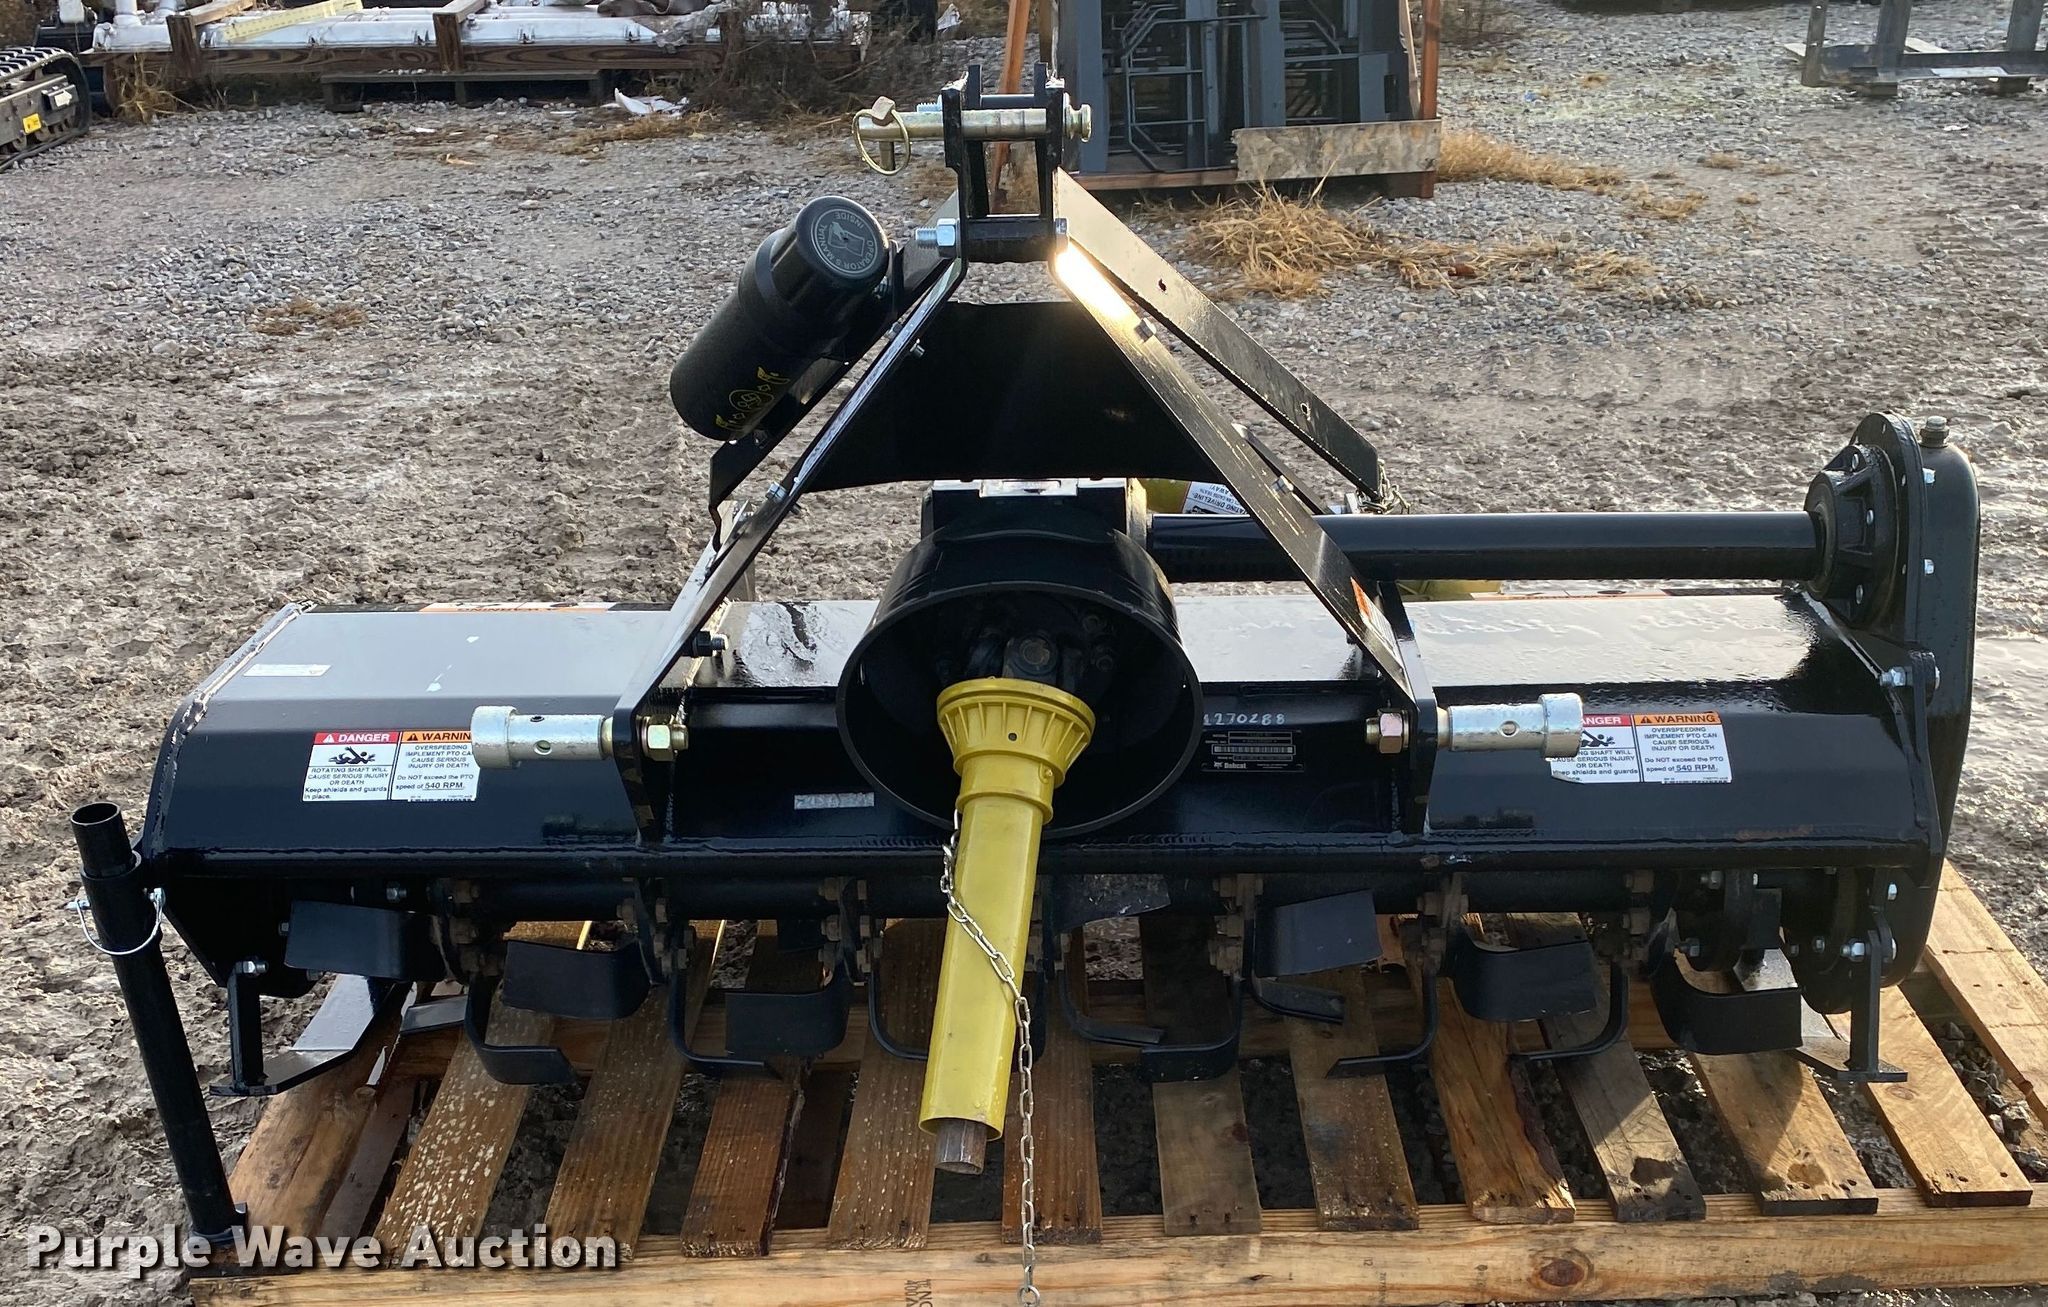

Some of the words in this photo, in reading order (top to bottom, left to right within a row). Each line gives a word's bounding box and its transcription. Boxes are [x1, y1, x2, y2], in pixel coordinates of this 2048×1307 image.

[834, 212, 864, 228] INSIDE
[818, 224, 835, 260] MANUAL
[1654, 714, 1715, 723] WARNING
[338, 733, 390, 742] DANGER
[422, 732, 471, 741] WARNIN
